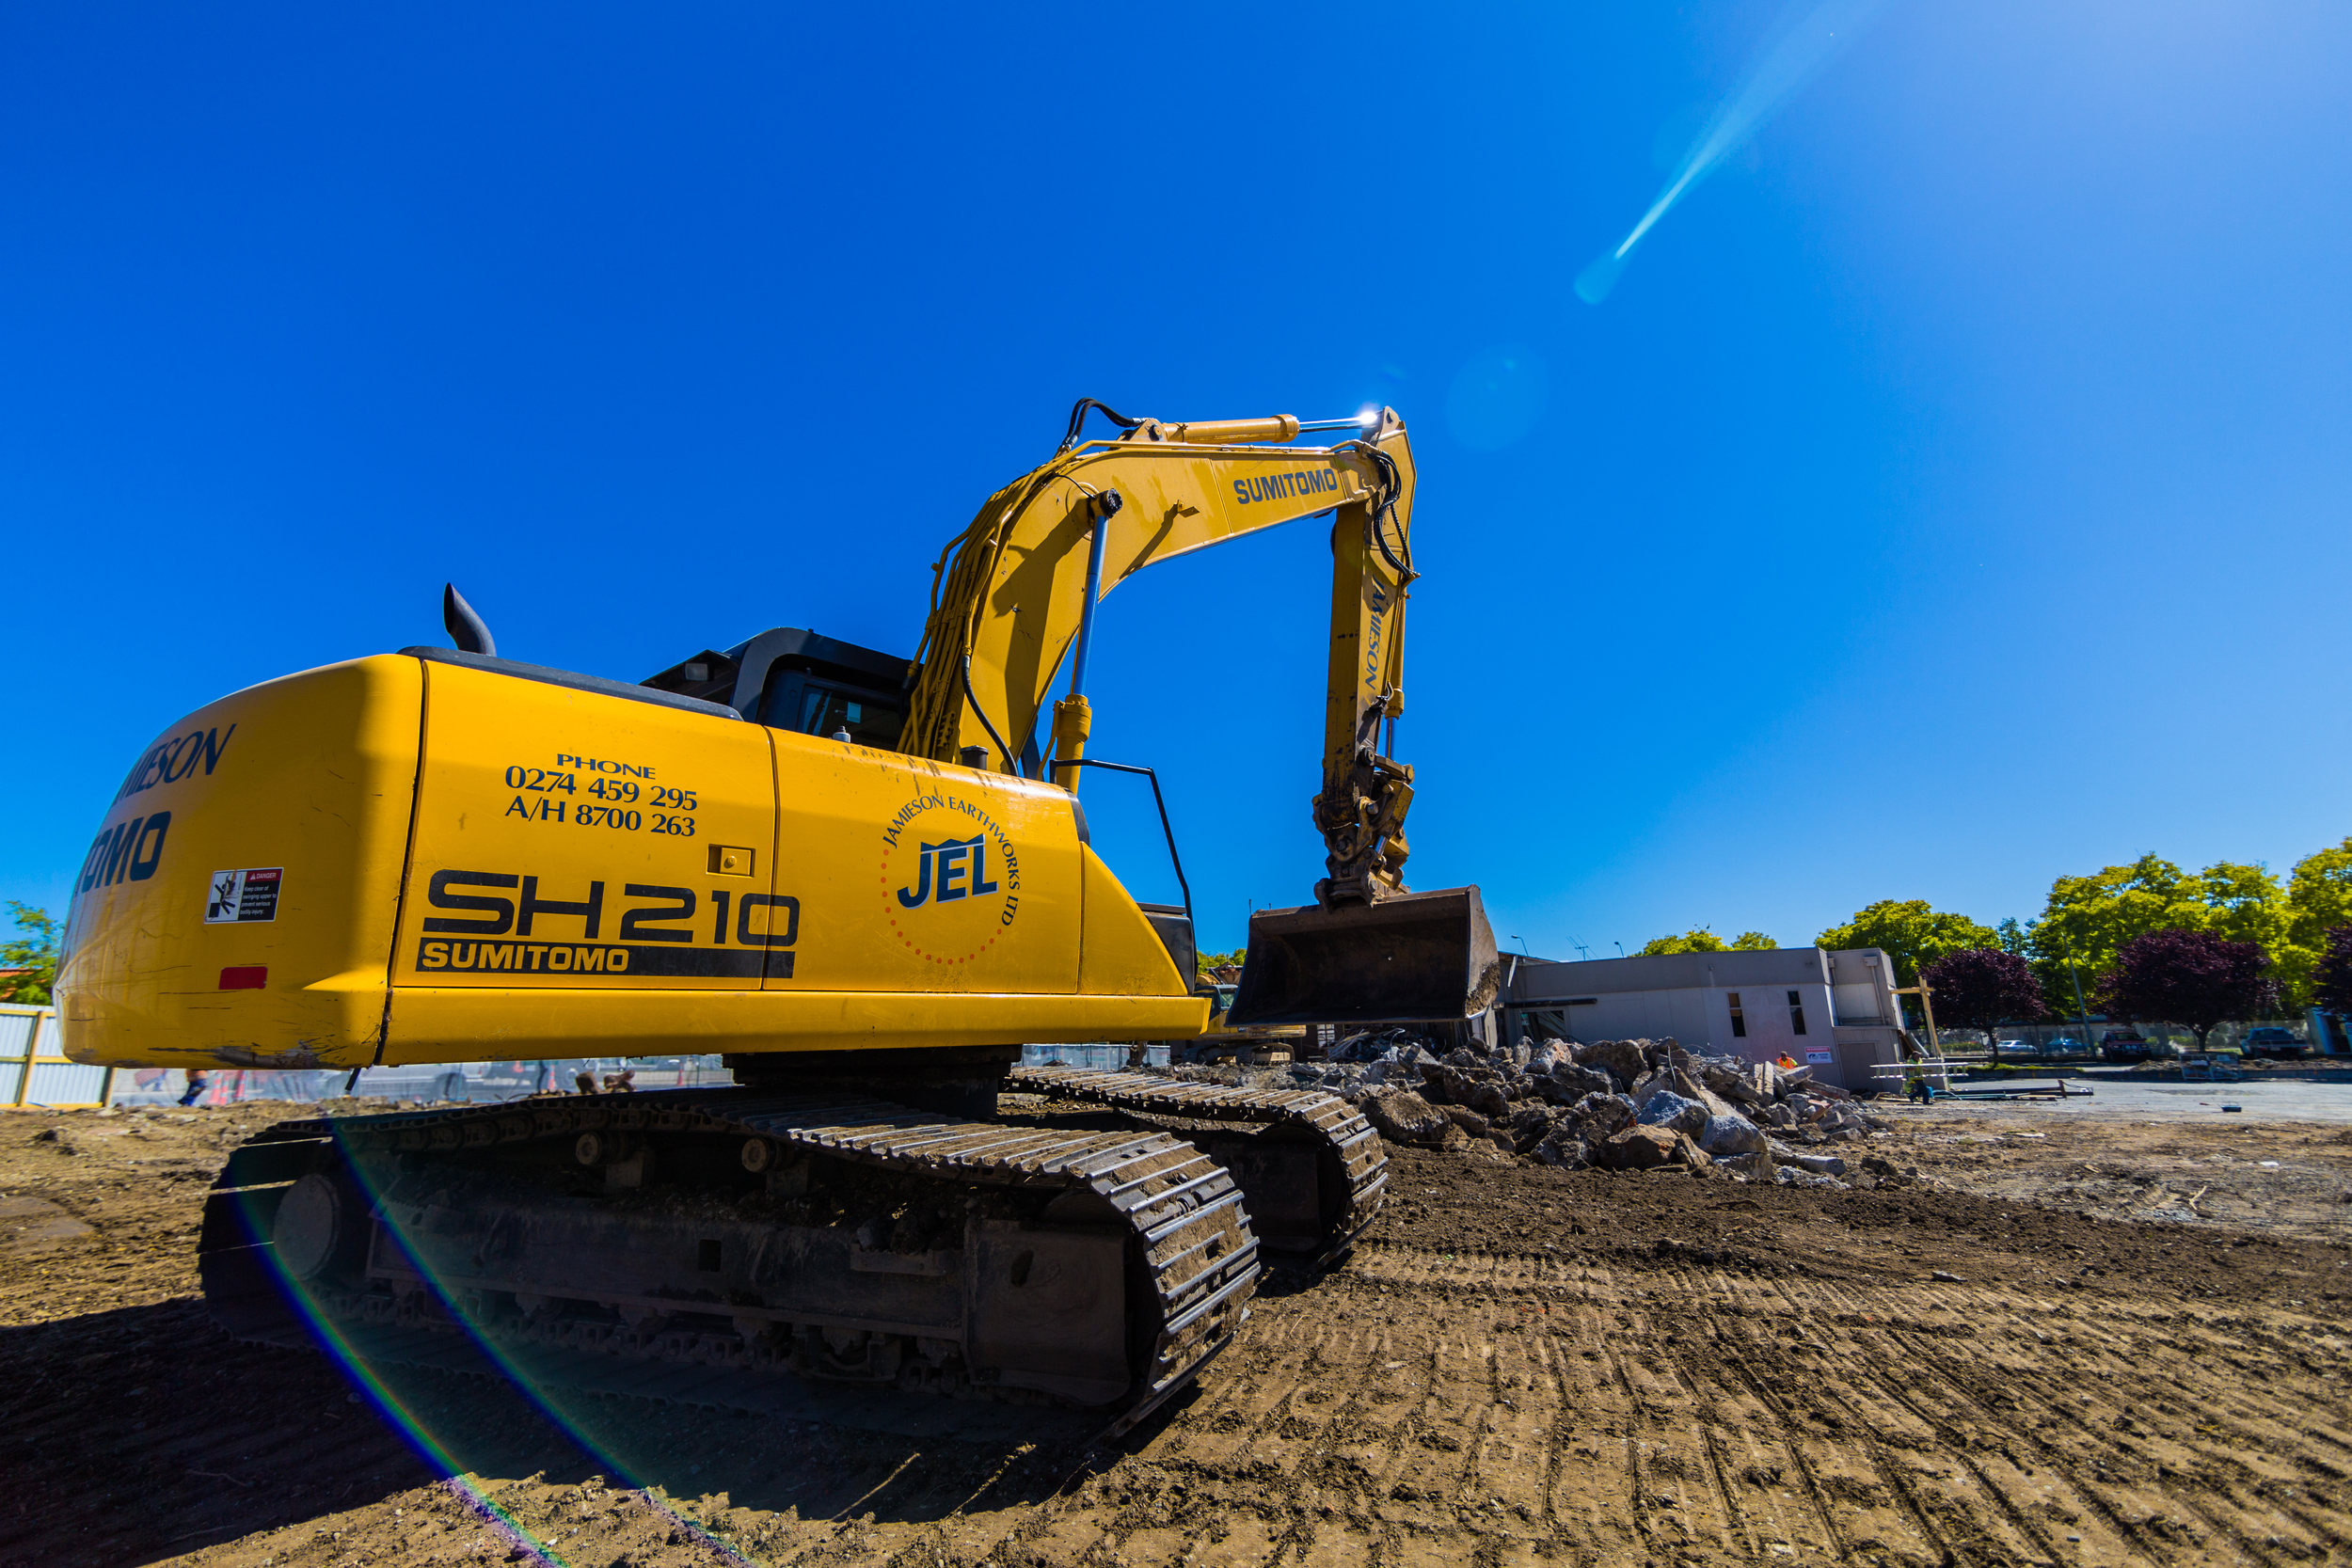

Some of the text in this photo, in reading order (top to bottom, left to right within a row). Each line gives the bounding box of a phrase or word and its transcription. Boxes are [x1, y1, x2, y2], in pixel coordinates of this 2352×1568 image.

[1232, 467, 1338, 504] SUMITOMO
[1365, 574, 1386, 690] JAMIESON
[111, 723, 237, 807] MIESON
[557, 753, 657, 780] PHONE
[505, 766, 698, 811] 0274 459 295
[505, 795, 695, 836] A/H 8700 263
[882, 795, 1020, 926] JAMIESON EARTHWORKS LTD
[897, 839, 998, 910] JEL
[421, 942, 629, 972] SUMITOMO
